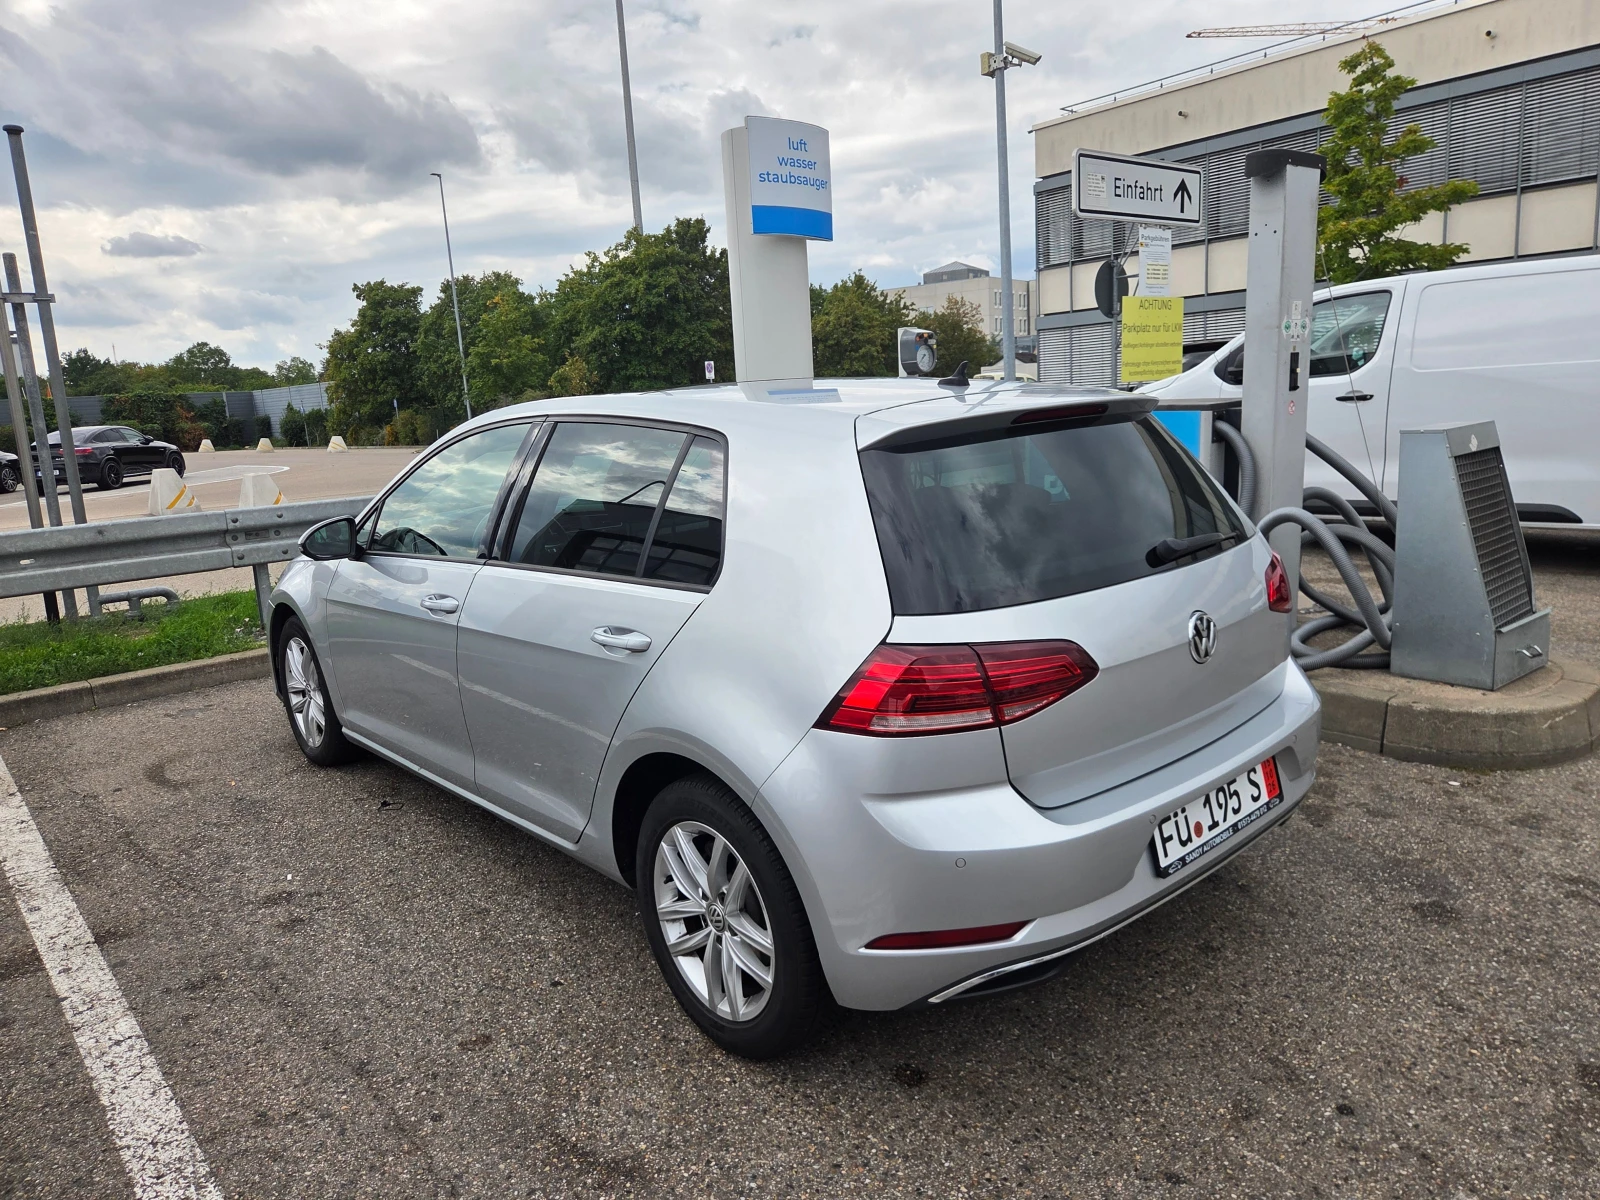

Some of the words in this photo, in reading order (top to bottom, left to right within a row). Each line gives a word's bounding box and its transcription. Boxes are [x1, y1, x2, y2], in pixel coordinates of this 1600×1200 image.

[787, 137, 808, 152] luft
[777, 156, 817, 171] wasser
[758, 171, 828, 191] staubsauger
[1114, 177, 1163, 202] Einfahrt
[1138, 299, 1172, 311] ACHTUNG
[1122, 322, 1151, 335] Parkplatz
[1152, 324, 1162, 333] nur
[1162, 322, 1171, 333] für
[1157, 806, 1193, 858] FÜ
[1203, 778, 1242, 832] 195
[1247, 766, 1262, 803] S
[1184, 847, 1204, 864] SANDY
[1203, 827, 1234, 853] AUTOMOBILE
